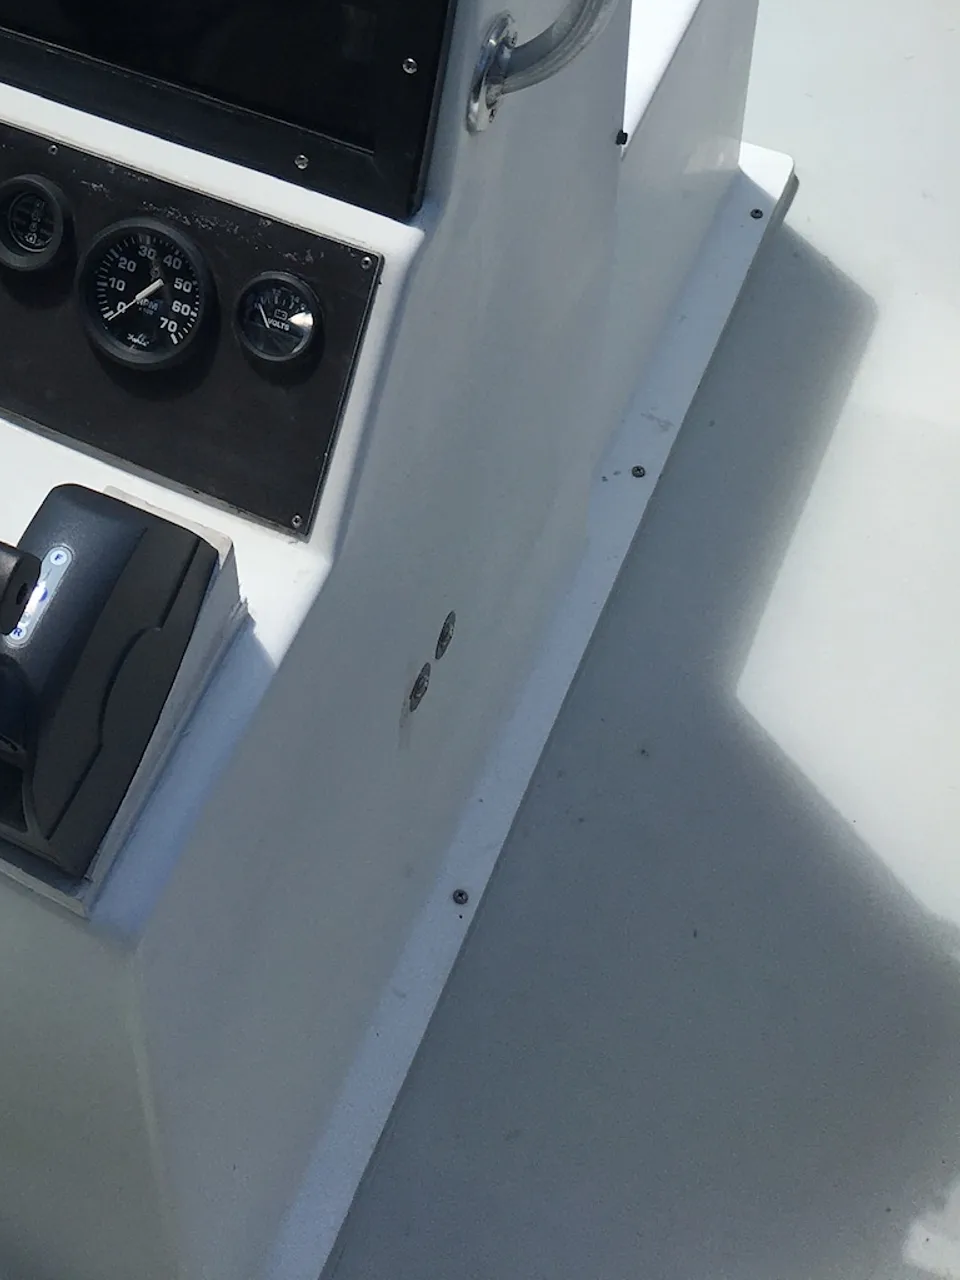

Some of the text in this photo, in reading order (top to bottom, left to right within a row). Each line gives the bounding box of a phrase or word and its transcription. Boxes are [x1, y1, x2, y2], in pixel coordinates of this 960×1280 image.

[138, 245, 157, 260] 30
[118, 256, 137, 273] 20
[163, 254, 182, 270] 40
[108, 277, 126, 292] 10
[174, 277, 192, 293] 50
[171, 300, 191, 316] 60
[159, 317, 178, 333] 70
[268, 317, 290, 331] VOLTS
[54, 553, 63, 561] F
[13, 627, 22, 636] R
